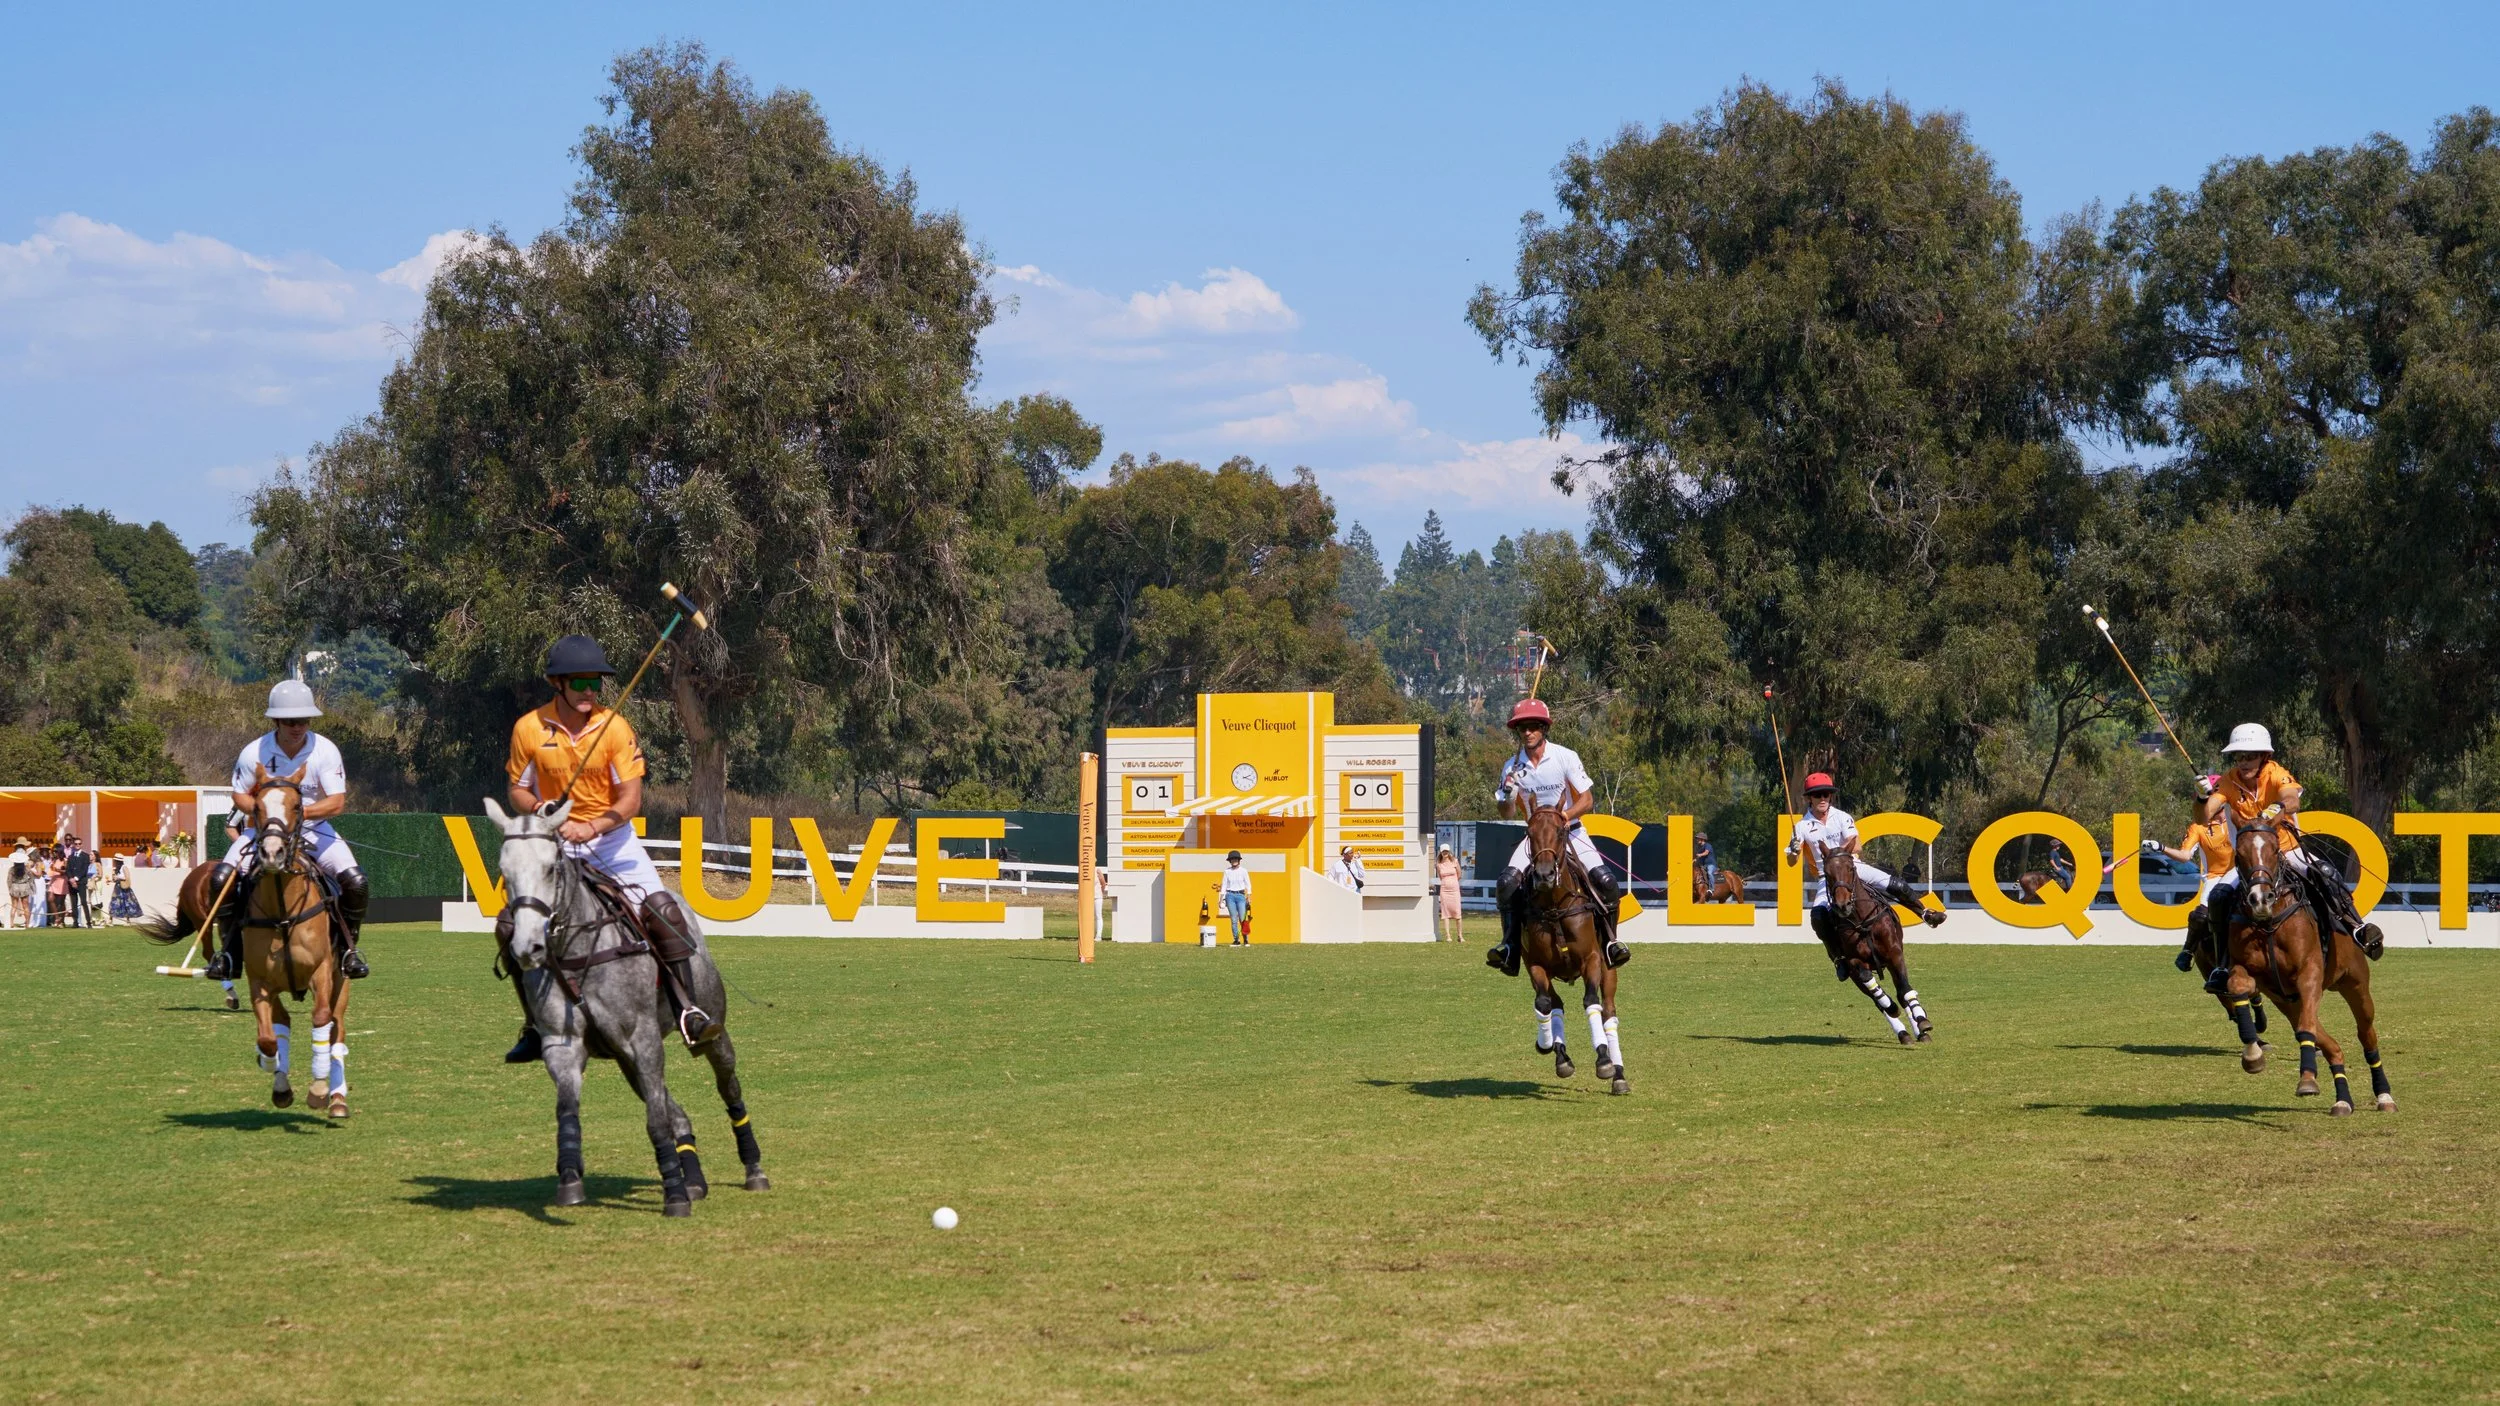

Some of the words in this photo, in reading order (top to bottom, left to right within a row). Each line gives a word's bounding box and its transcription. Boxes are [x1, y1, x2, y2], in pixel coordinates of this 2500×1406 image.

[1221, 719, 1251, 731] Veuve
[1254, 718, 1297, 733] Clicquot
[541, 725, 558, 748] 2
[265, 755, 281, 773] 4
[1158, 785, 1169, 798] 1
[1082, 801, 1094, 833] Veuve
[1233, 819, 1253, 828] Veuve
[1255, 818, 1285, 829] Clicquot
[1080, 836, 1093, 881] Clicquot
[442, 816, 1006, 923] VUVE
